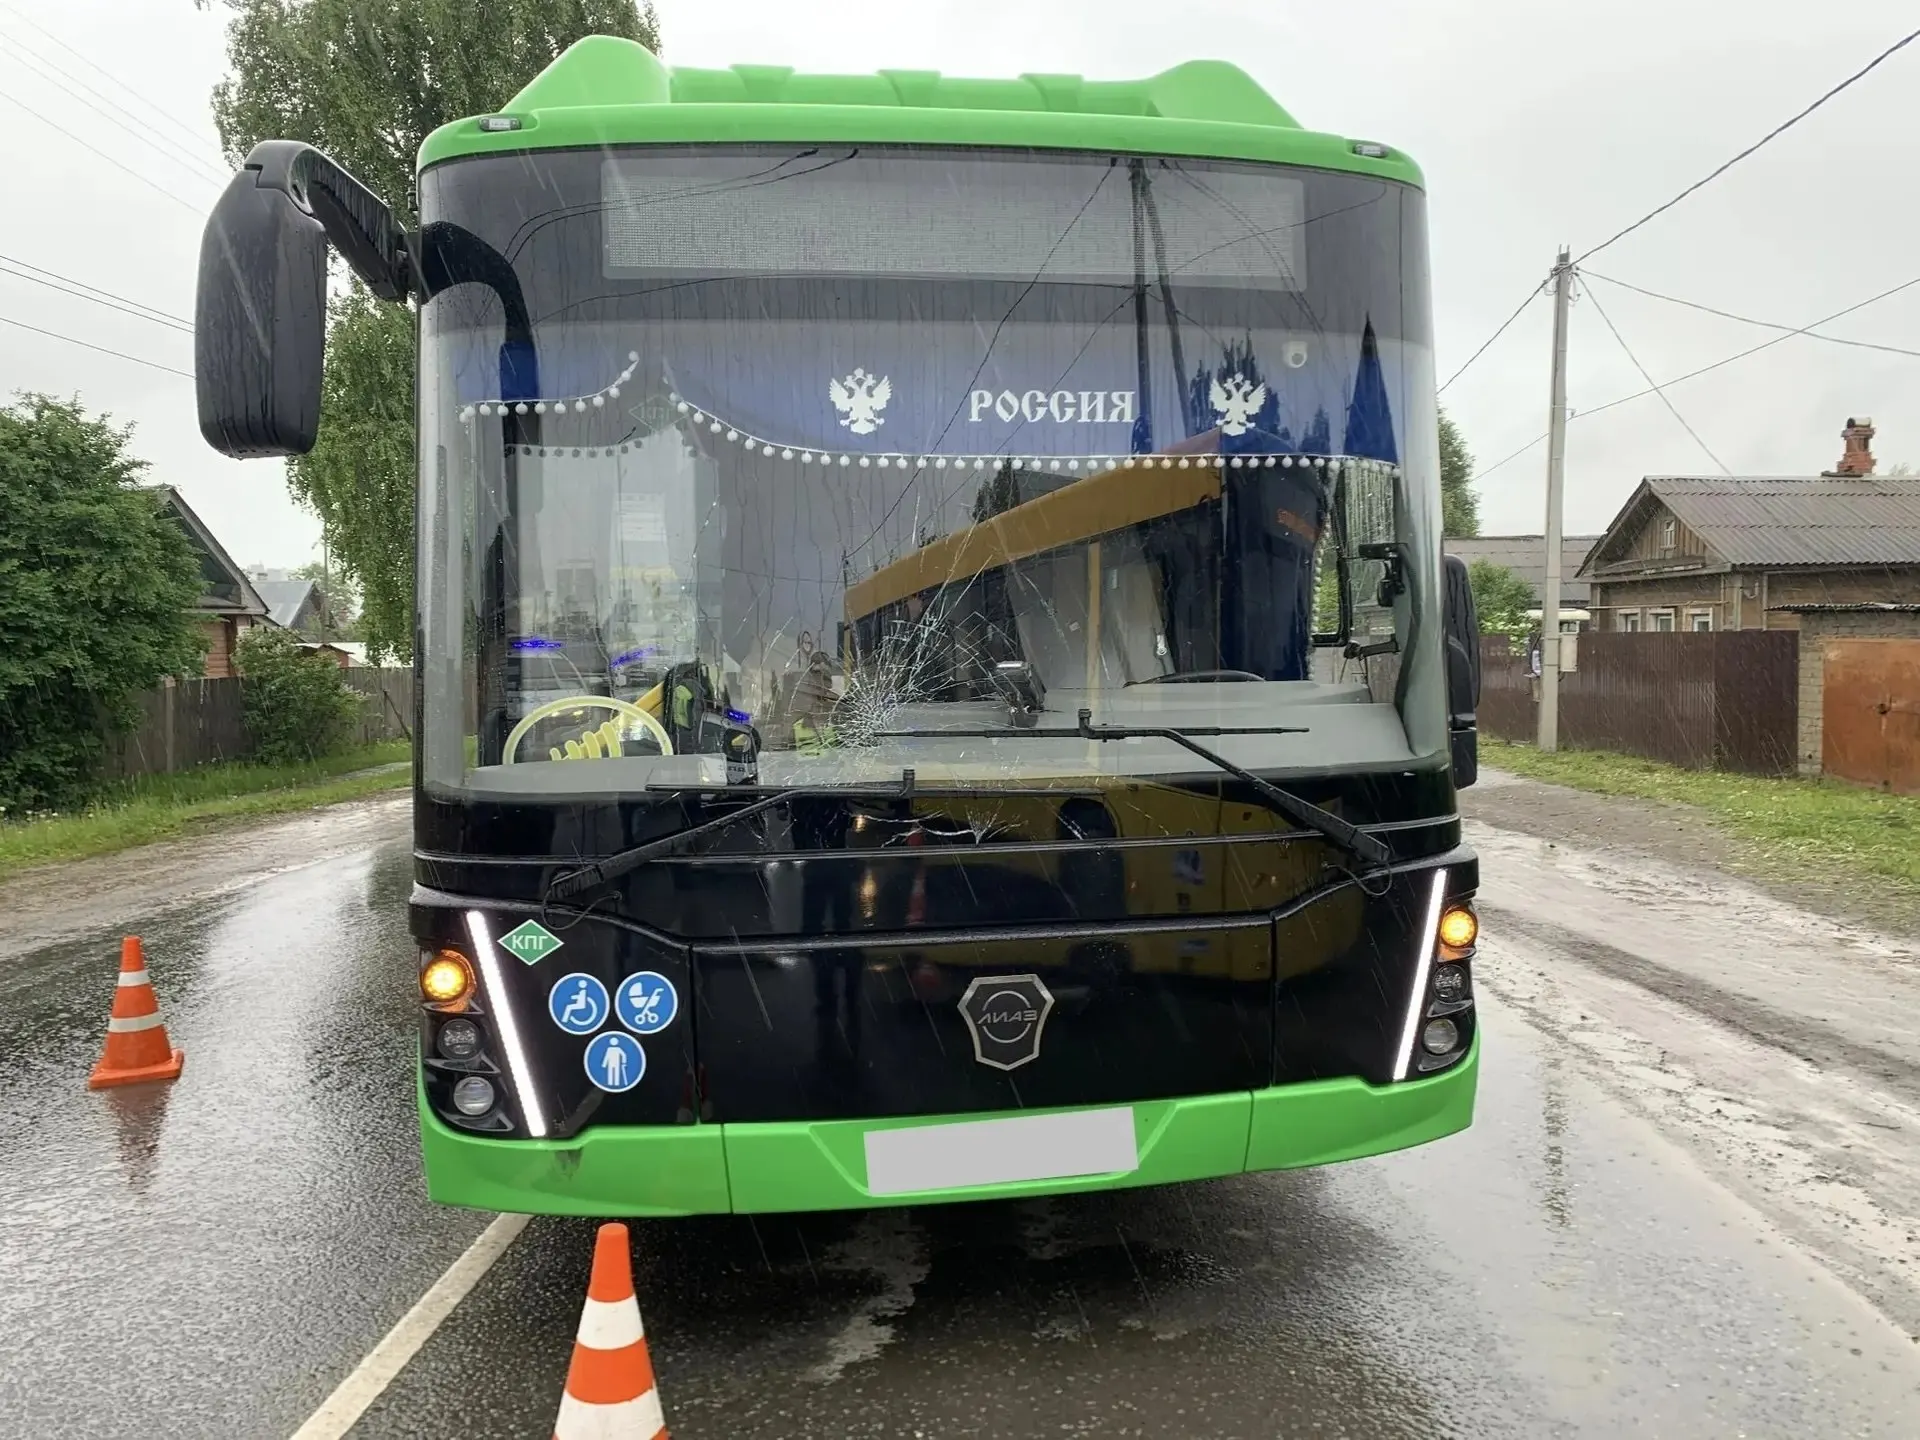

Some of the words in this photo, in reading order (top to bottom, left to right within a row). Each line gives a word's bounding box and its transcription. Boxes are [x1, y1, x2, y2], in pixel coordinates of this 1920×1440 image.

[968, 389, 1135, 422] РОССИЯ
[512, 935, 548, 950] КПГ
[977, 1009, 1037, 1024] ЛИАЗ
